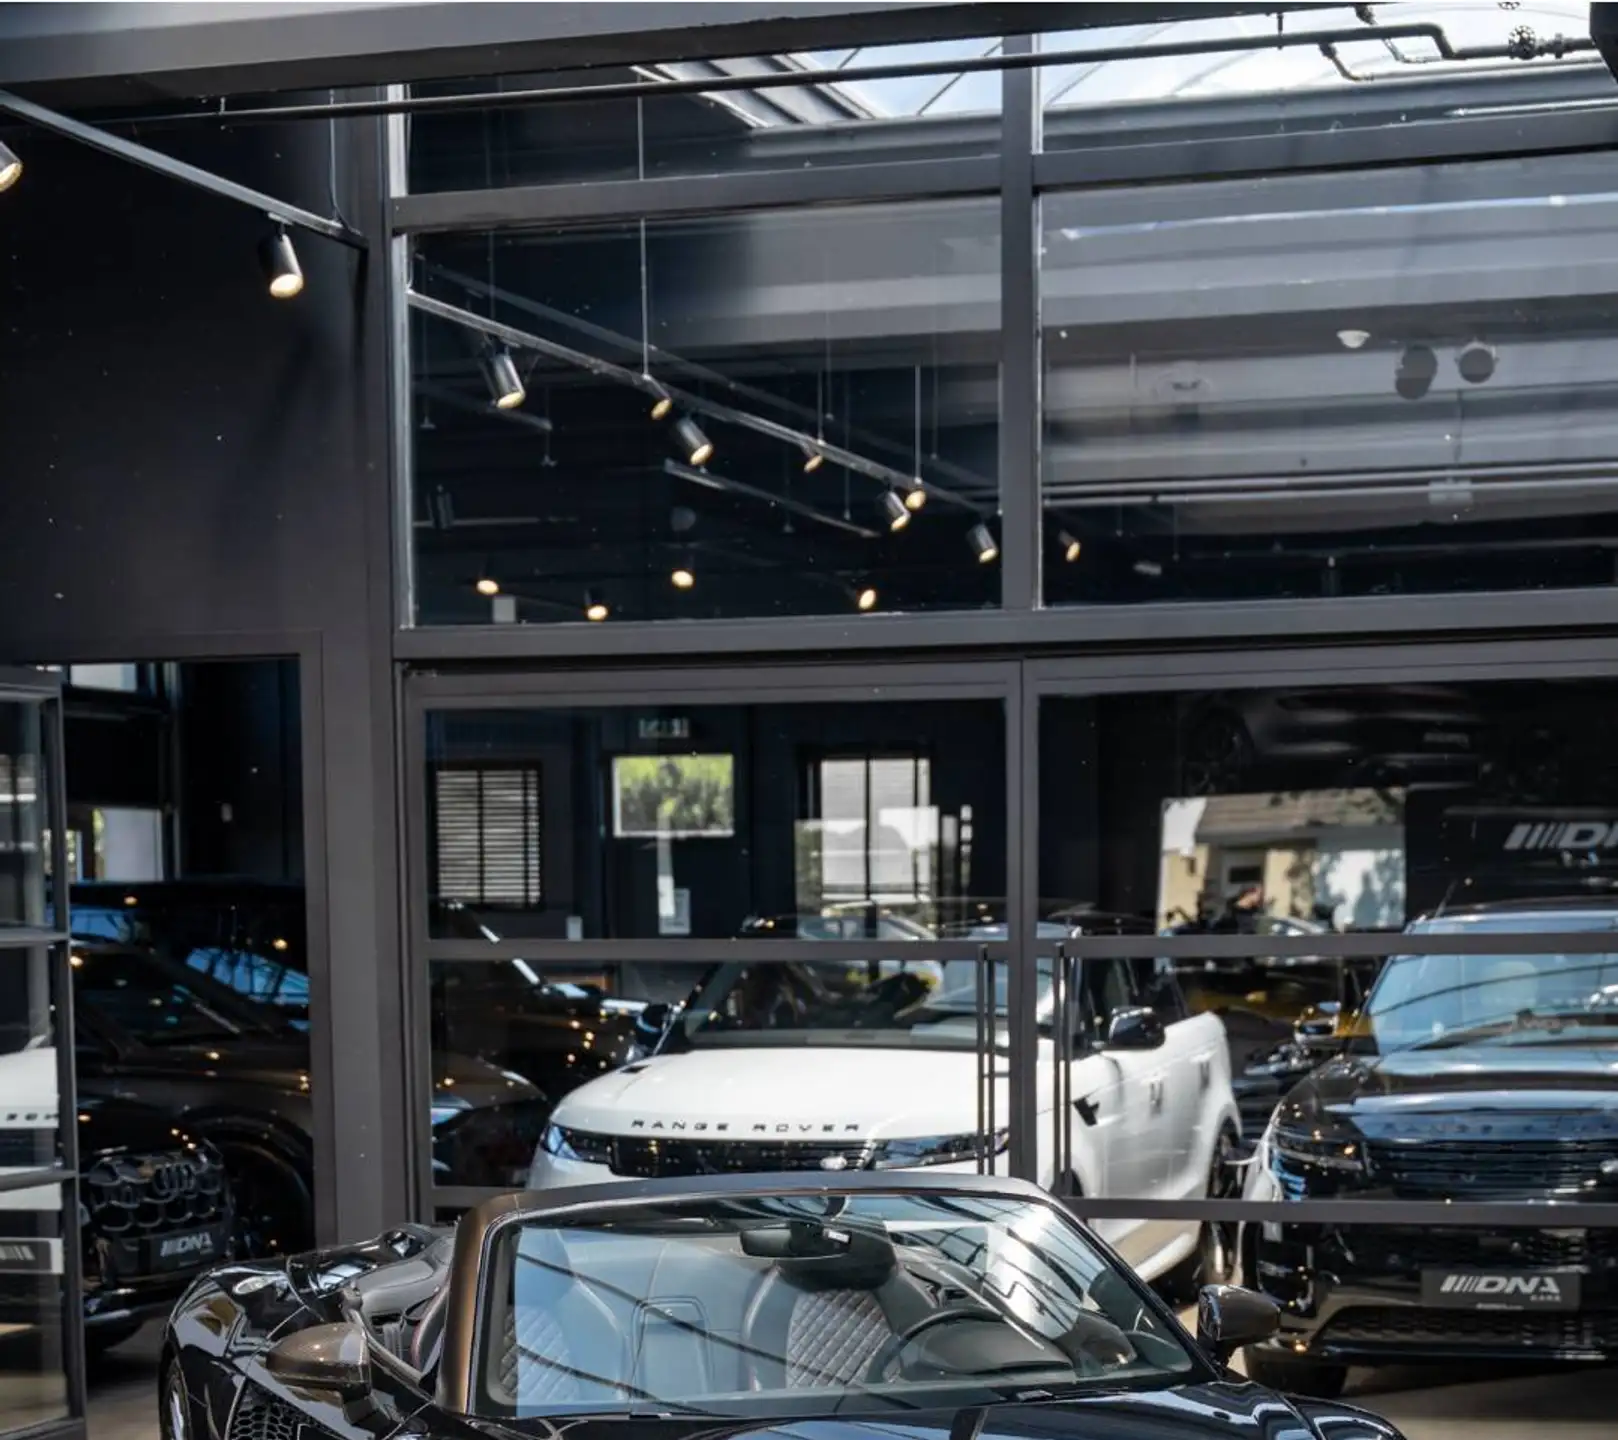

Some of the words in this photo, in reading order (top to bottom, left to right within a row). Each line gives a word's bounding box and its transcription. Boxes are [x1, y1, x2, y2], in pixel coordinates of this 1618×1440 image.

[631, 1119, 729, 1132] RANGE
[752, 1123, 860, 1133] ROVER
[1474, 1276, 1560, 1293] DNA
